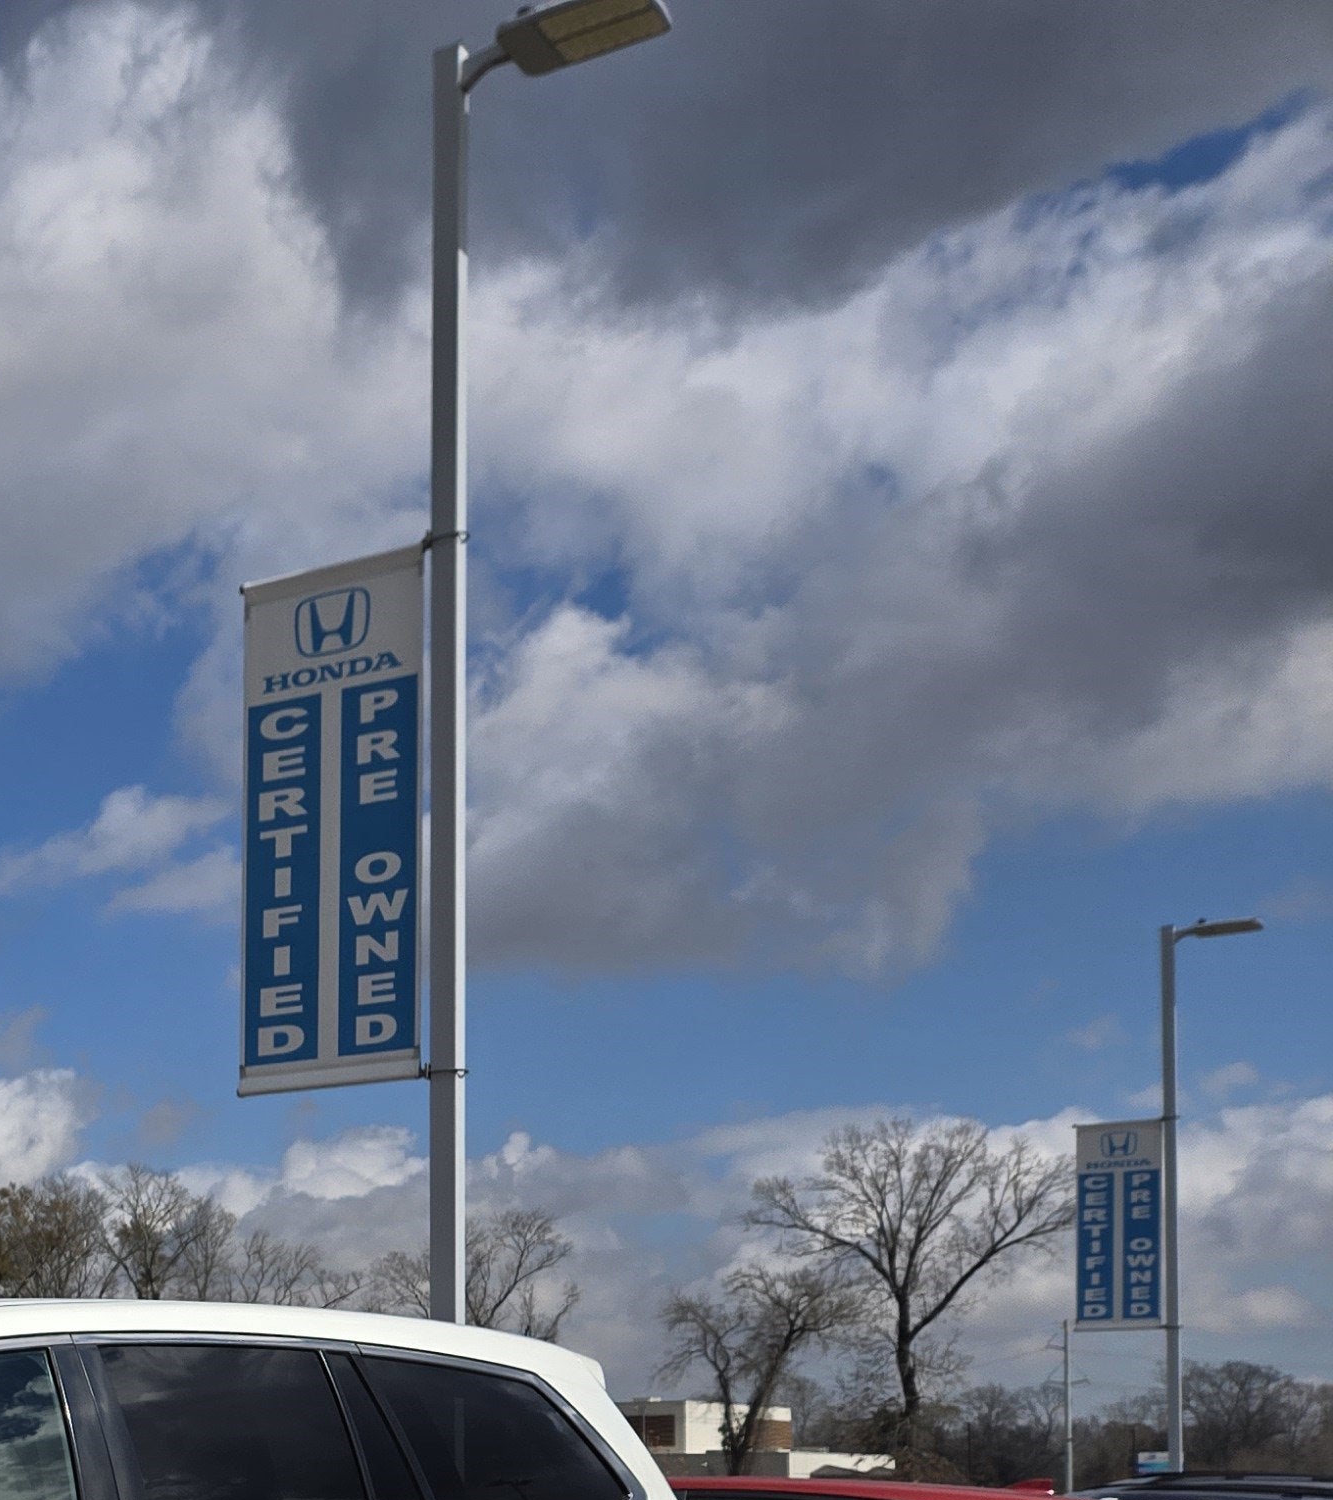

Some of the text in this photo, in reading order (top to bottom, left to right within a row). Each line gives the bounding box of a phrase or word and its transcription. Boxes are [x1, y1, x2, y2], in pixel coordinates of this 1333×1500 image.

[263, 651, 402, 694] HONDA
[257, 707, 309, 1057] CERTIFIED
[347, 688, 409, 1048] PRE OWNED
[1082, 1175, 1109, 1318] CERTIFIED
[1126, 1172, 1156, 1316] PRE OWNED
